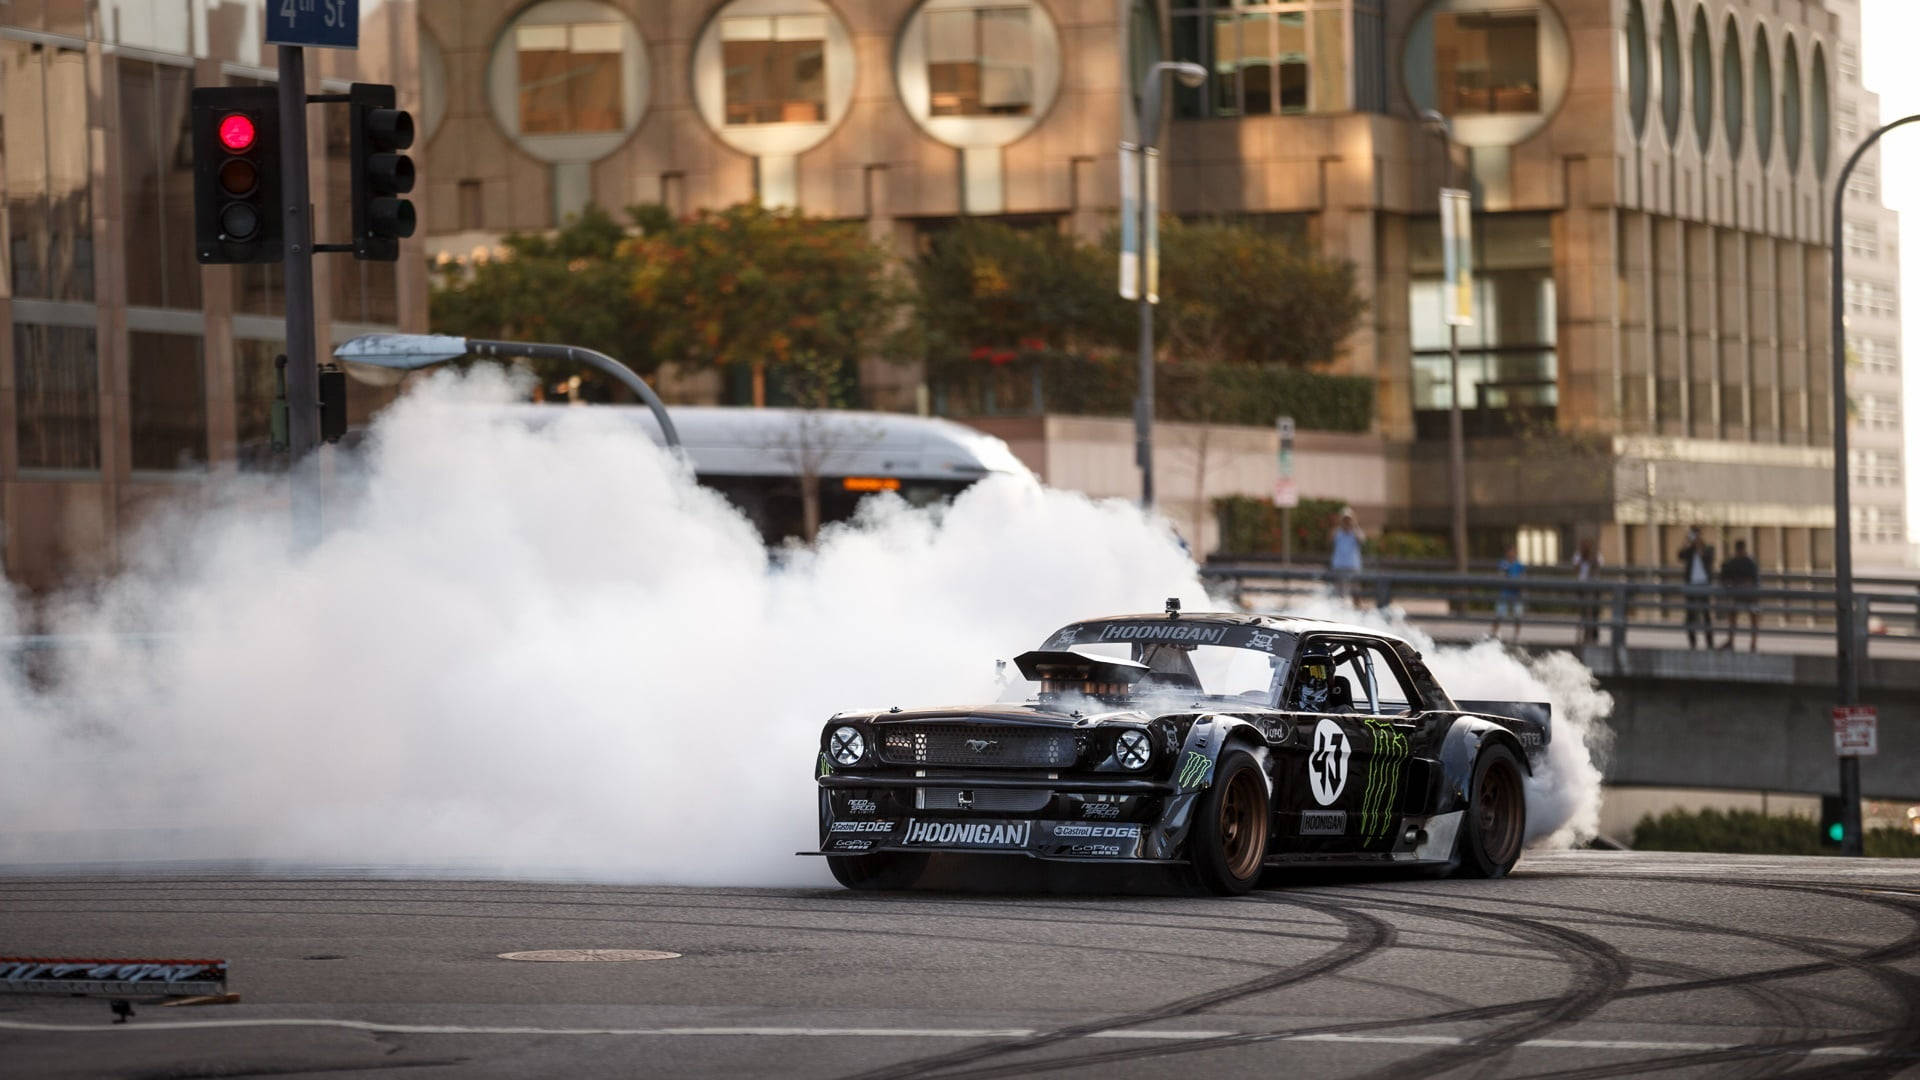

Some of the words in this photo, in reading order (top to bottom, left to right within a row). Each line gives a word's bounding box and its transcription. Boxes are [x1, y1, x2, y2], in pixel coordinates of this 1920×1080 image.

[324, 0, 346, 28] St
[1262, 719, 1285, 738] Ford
[856, 822, 896, 832] EDGE
[1063, 827, 1089, 836] Castrol
[1091, 827, 1140, 838] EDGE
